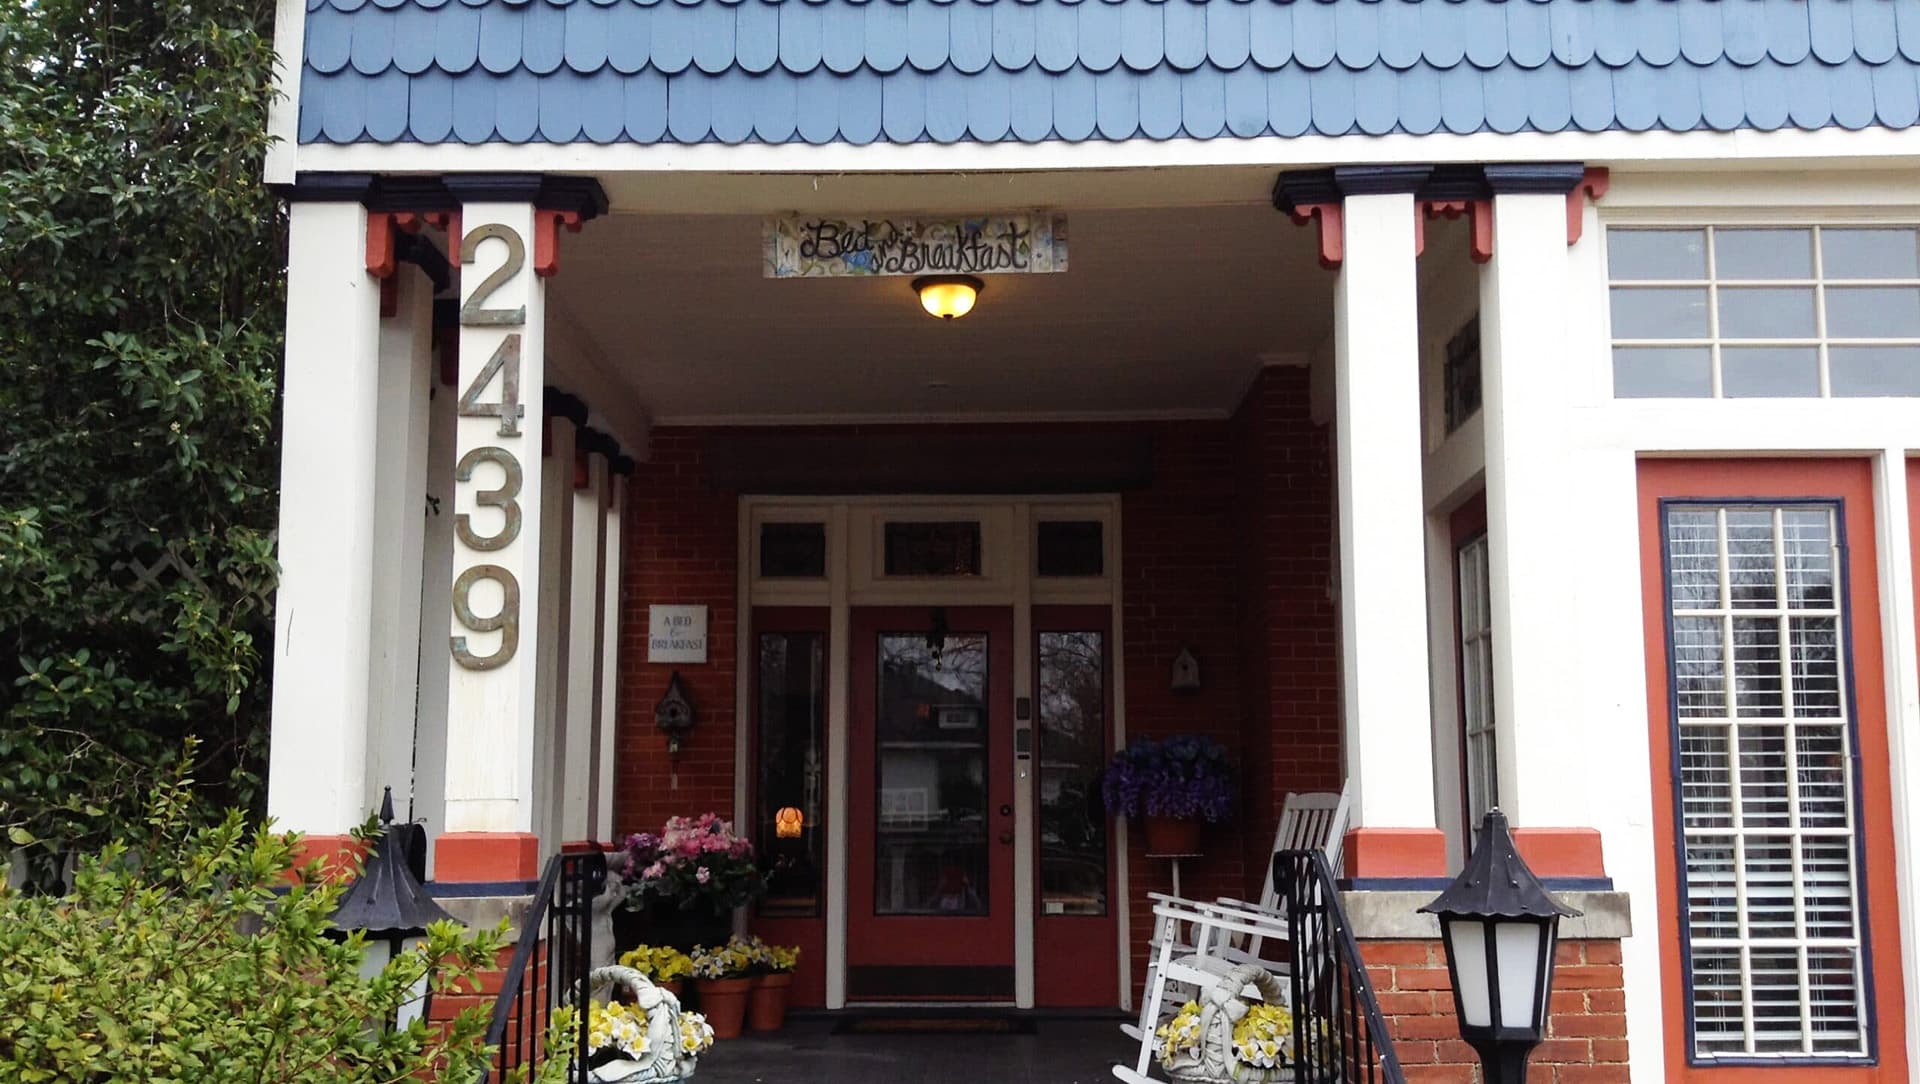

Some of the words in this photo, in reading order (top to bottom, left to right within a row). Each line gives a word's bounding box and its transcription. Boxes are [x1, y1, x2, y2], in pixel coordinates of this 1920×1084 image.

[799, 218, 874, 259] Bed
[885, 220, 1030, 274] Breakfast
[449, 222, 526, 671] 2439
[663, 615, 672, 626] A
